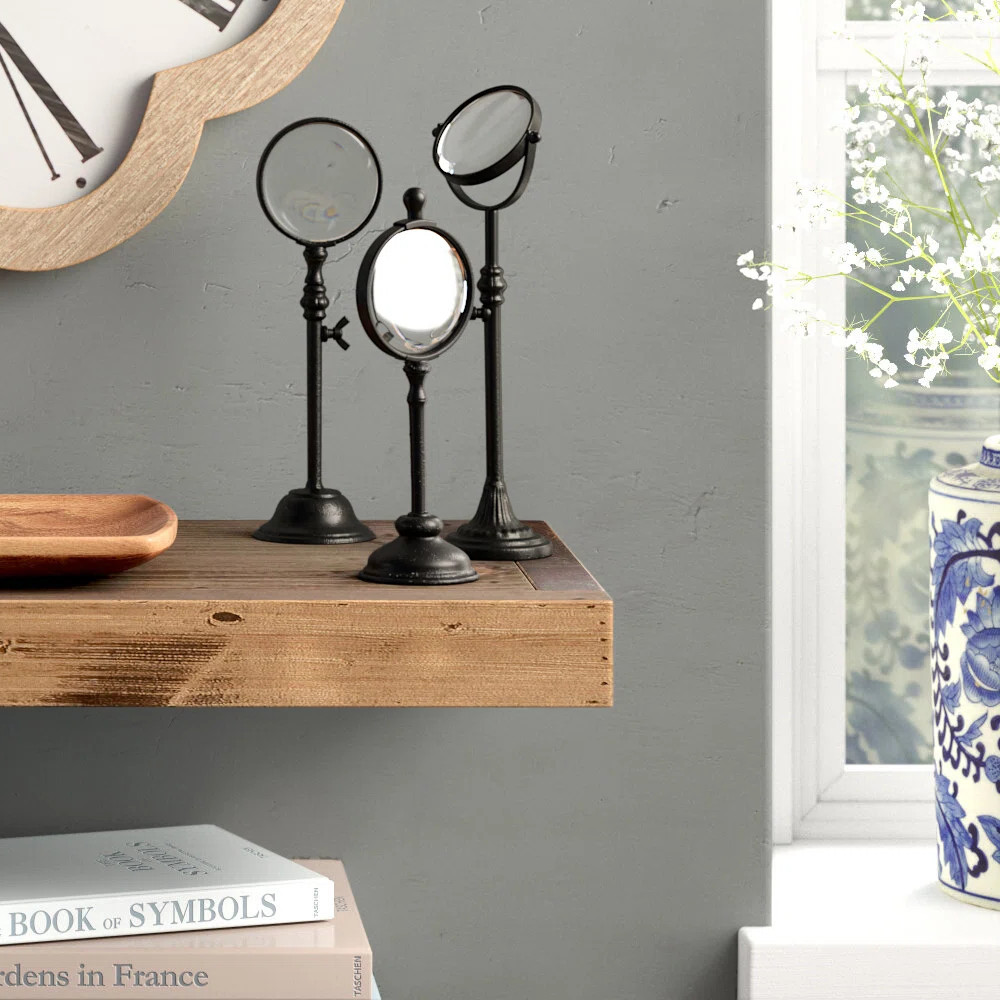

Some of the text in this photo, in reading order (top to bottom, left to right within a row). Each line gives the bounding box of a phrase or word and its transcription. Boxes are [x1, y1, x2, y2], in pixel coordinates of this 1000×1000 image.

[9, 907, 96, 937] BOOK
[103, 916, 122, 930] OF
[129, 893, 277, 928] SYMBOLS
[77, 963, 105, 987] in
[113, 964, 209, 987] France
[353, 956, 362, 997] TASCHEN
